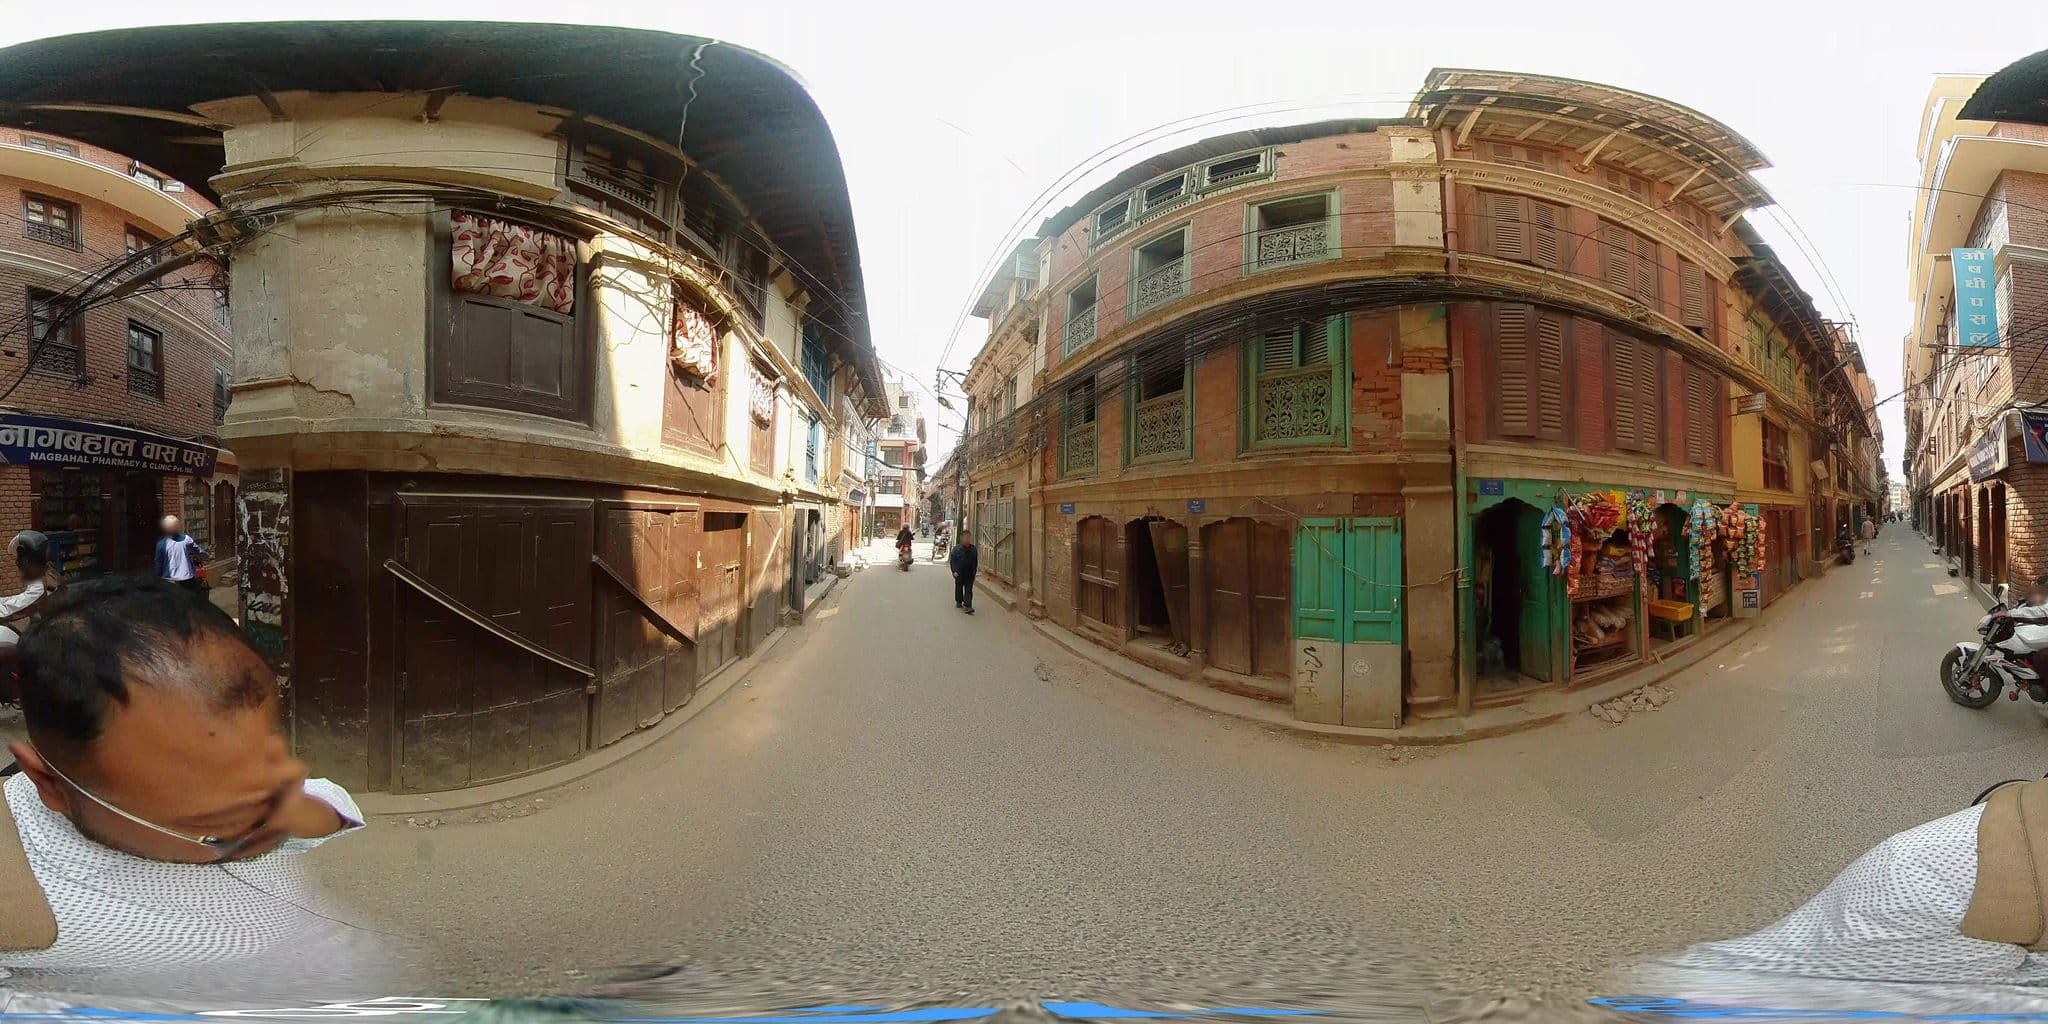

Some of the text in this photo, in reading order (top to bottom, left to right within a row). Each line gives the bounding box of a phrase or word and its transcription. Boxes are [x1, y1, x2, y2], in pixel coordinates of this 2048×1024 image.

[30, 452, 90, 463] NAGBAHAL
[92, 457, 140, 467] PHARMACY
[149, 462, 172, 471] CLINIC
